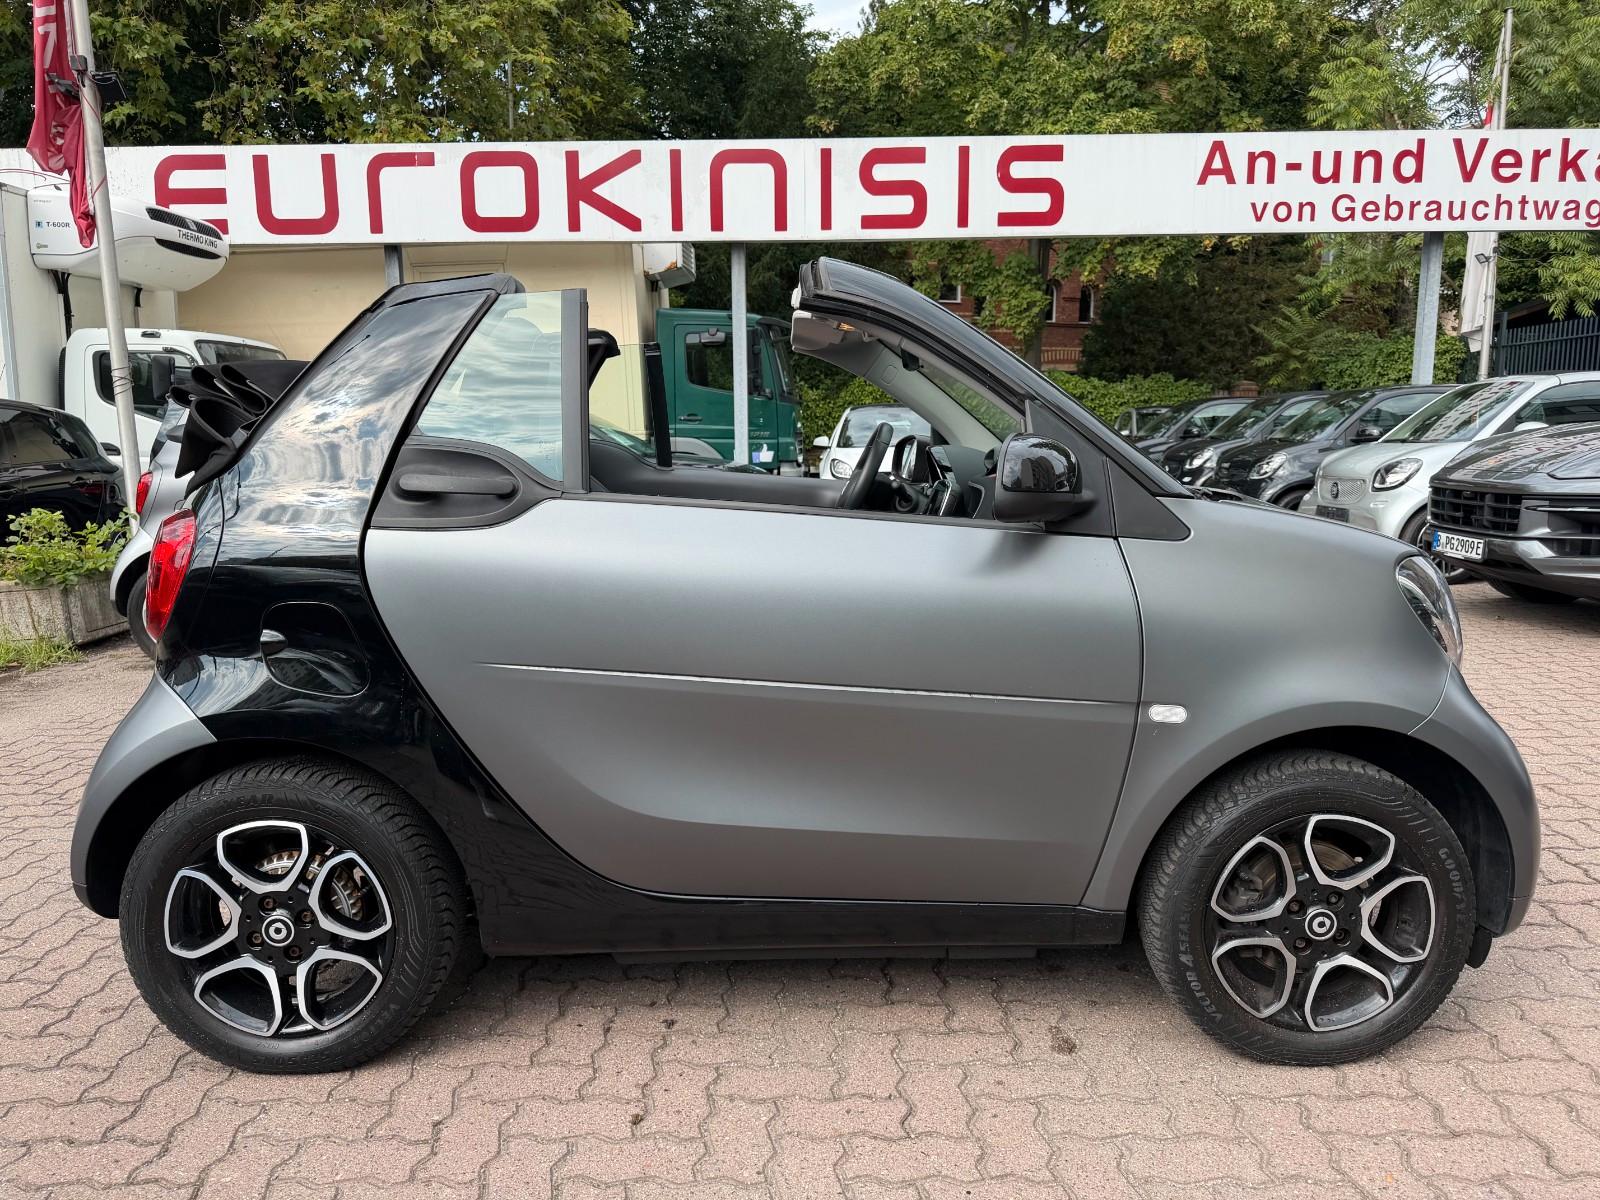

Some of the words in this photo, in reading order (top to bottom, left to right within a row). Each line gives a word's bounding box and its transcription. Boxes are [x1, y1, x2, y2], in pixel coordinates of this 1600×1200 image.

[1197, 138, 1426, 186] An-und
[1452, 137, 1600, 184] Verk
[1250, 201, 1316, 223] von
[1331, 193, 1600, 228] Gebrauchtwag
[177, 229, 204, 245] THERMO
[204, 237, 218, 249] KING
